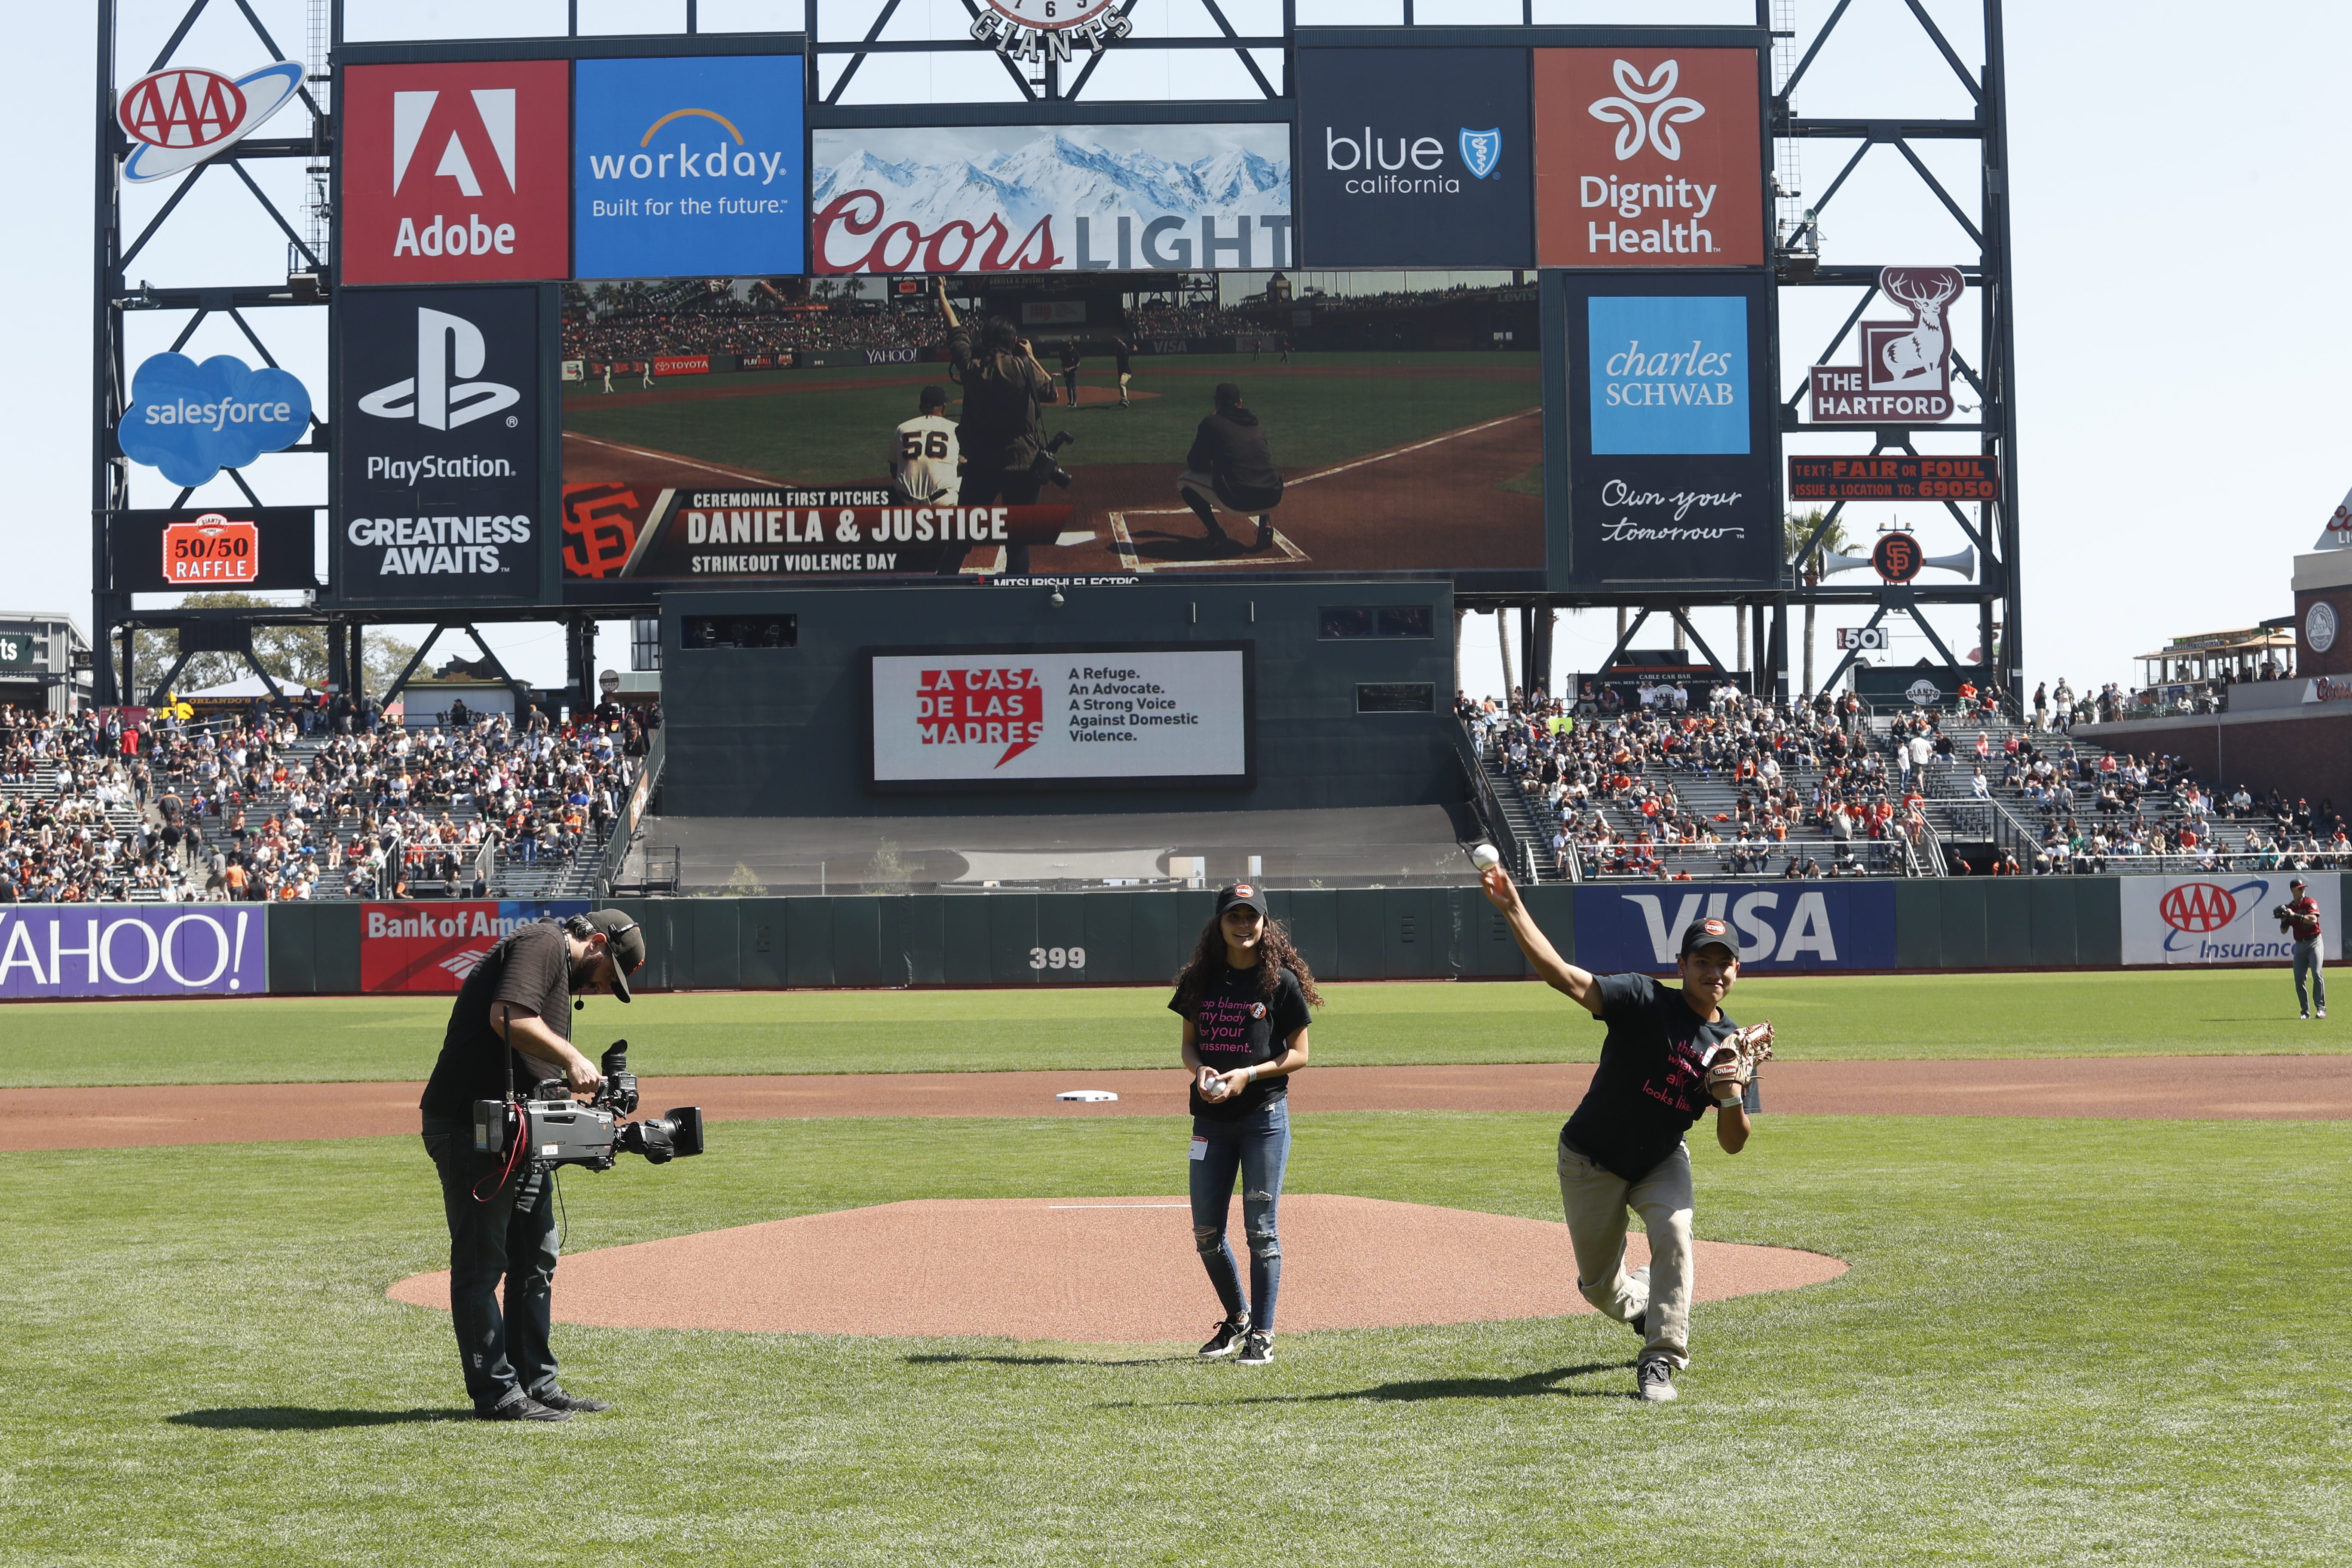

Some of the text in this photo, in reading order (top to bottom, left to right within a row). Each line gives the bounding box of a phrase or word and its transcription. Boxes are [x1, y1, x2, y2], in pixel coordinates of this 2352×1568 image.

[1045, 1, 1056, 17] 6
[970, 5, 1133, 63] GIANTS
[127, 70, 239, 148] AAA
[1326, 126, 1444, 171] blue
[1345, 175, 1460, 193] california
[593, 199, 638, 216] Built
[644, 198, 674, 216] for
[680, 197, 712, 214] the
[1580, 174, 1717, 218] Dignity
[393, 214, 515, 257] Adobe
[813, 189, 1291, 273] Coors LIGHT
[1589, 219, 1712, 253] Health
[866, 348, 917, 364] YAHOO!
[1152, 340, 1187, 353] VISA
[671, 360, 708, 370] TOYOTA
[1606, 340, 1732, 377] charles
[1818, 374, 1862, 391] THE
[1606, 383, 1734, 406] SCHWAB
[145, 396, 291, 432] salesforce
[1818, 397, 1947, 415] HARTFORD
[902, 431, 949, 460] 56
[368, 454, 510, 487] PlayStation
[1795, 461, 1984, 479] TEXT: FAIR OR FOUL
[693, 490, 889, 508] CEREMONIAL FIRST PITCHES
[1602, 478, 1742, 521] Own your
[1795, 481, 1994, 497] ISSUE & LOCATION TO: 69050
[347, 515, 531, 546] GREATNESS
[688, 507, 1008, 545] DANIELA & JUSTICE
[1602, 517, 1744, 542] tomorrow
[175, 538, 248, 558] 50/50
[2338, 531, 2352, 544] LI
[176, 560, 247, 578] RAFFLE
[380, 545, 500, 575] AWAITS
[692, 552, 897, 573] STRIKEOUT VIOLENCE DAY
[1845, 628, 1887, 649] 501
[921, 668, 1043, 691] LA CASA
[1069, 667, 1140, 682] A Refuge.
[1069, 682, 1165, 695] An Advocate.
[1907, 688, 1939, 698] GIANTS
[917, 695, 1025, 718] DE LAS
[1069, 698, 1176, 713] A Strong Voice
[1069, 713, 1198, 729] Against Domestic
[918, 721, 1044, 744] MADRES
[1069, 730, 1137, 742] Violence.
[2163, 883, 2232, 933] AAA
[368, 912, 436, 938] Bank
[439, 911, 468, 937] of
[0, 911, 248, 990] AHOO!
[1029, 947, 1086, 969] 399
[1218, 996, 1252, 1010] blamin
[1199, 1009, 1246, 1026] my body
[1211, 1027, 1245, 1041] your
[1677, 1039, 1697, 1058] this
[1668, 1053, 1691, 1072] what
[1715, 1066, 1737, 1075] Wilson
[1666, 1069, 1689, 1093] ally
[1642, 1079, 1692, 1112] looks like.
